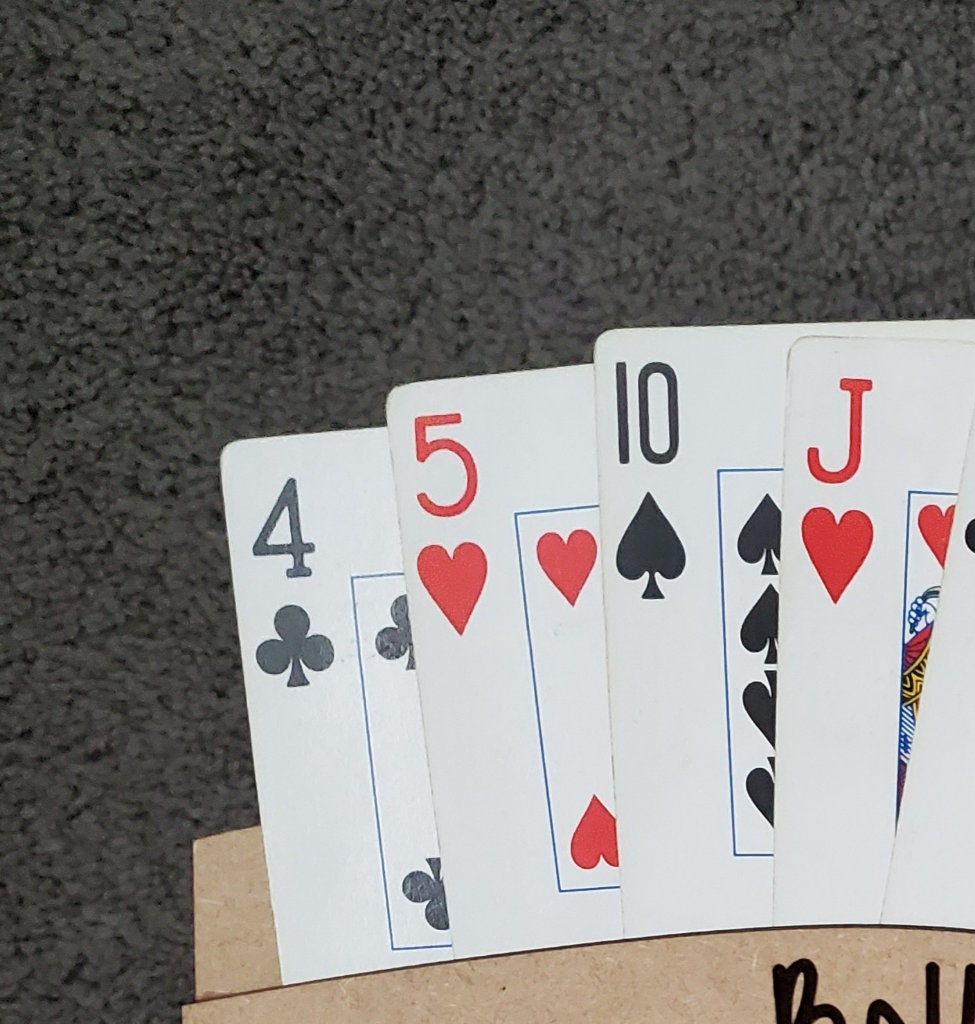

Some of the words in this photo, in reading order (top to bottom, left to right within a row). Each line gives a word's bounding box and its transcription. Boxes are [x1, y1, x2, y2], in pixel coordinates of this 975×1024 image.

[413, 412, 480, 518] 5
[614, 360, 680, 466] 10
[805, 377, 874, 485] J
[251, 476, 316, 578] 4
